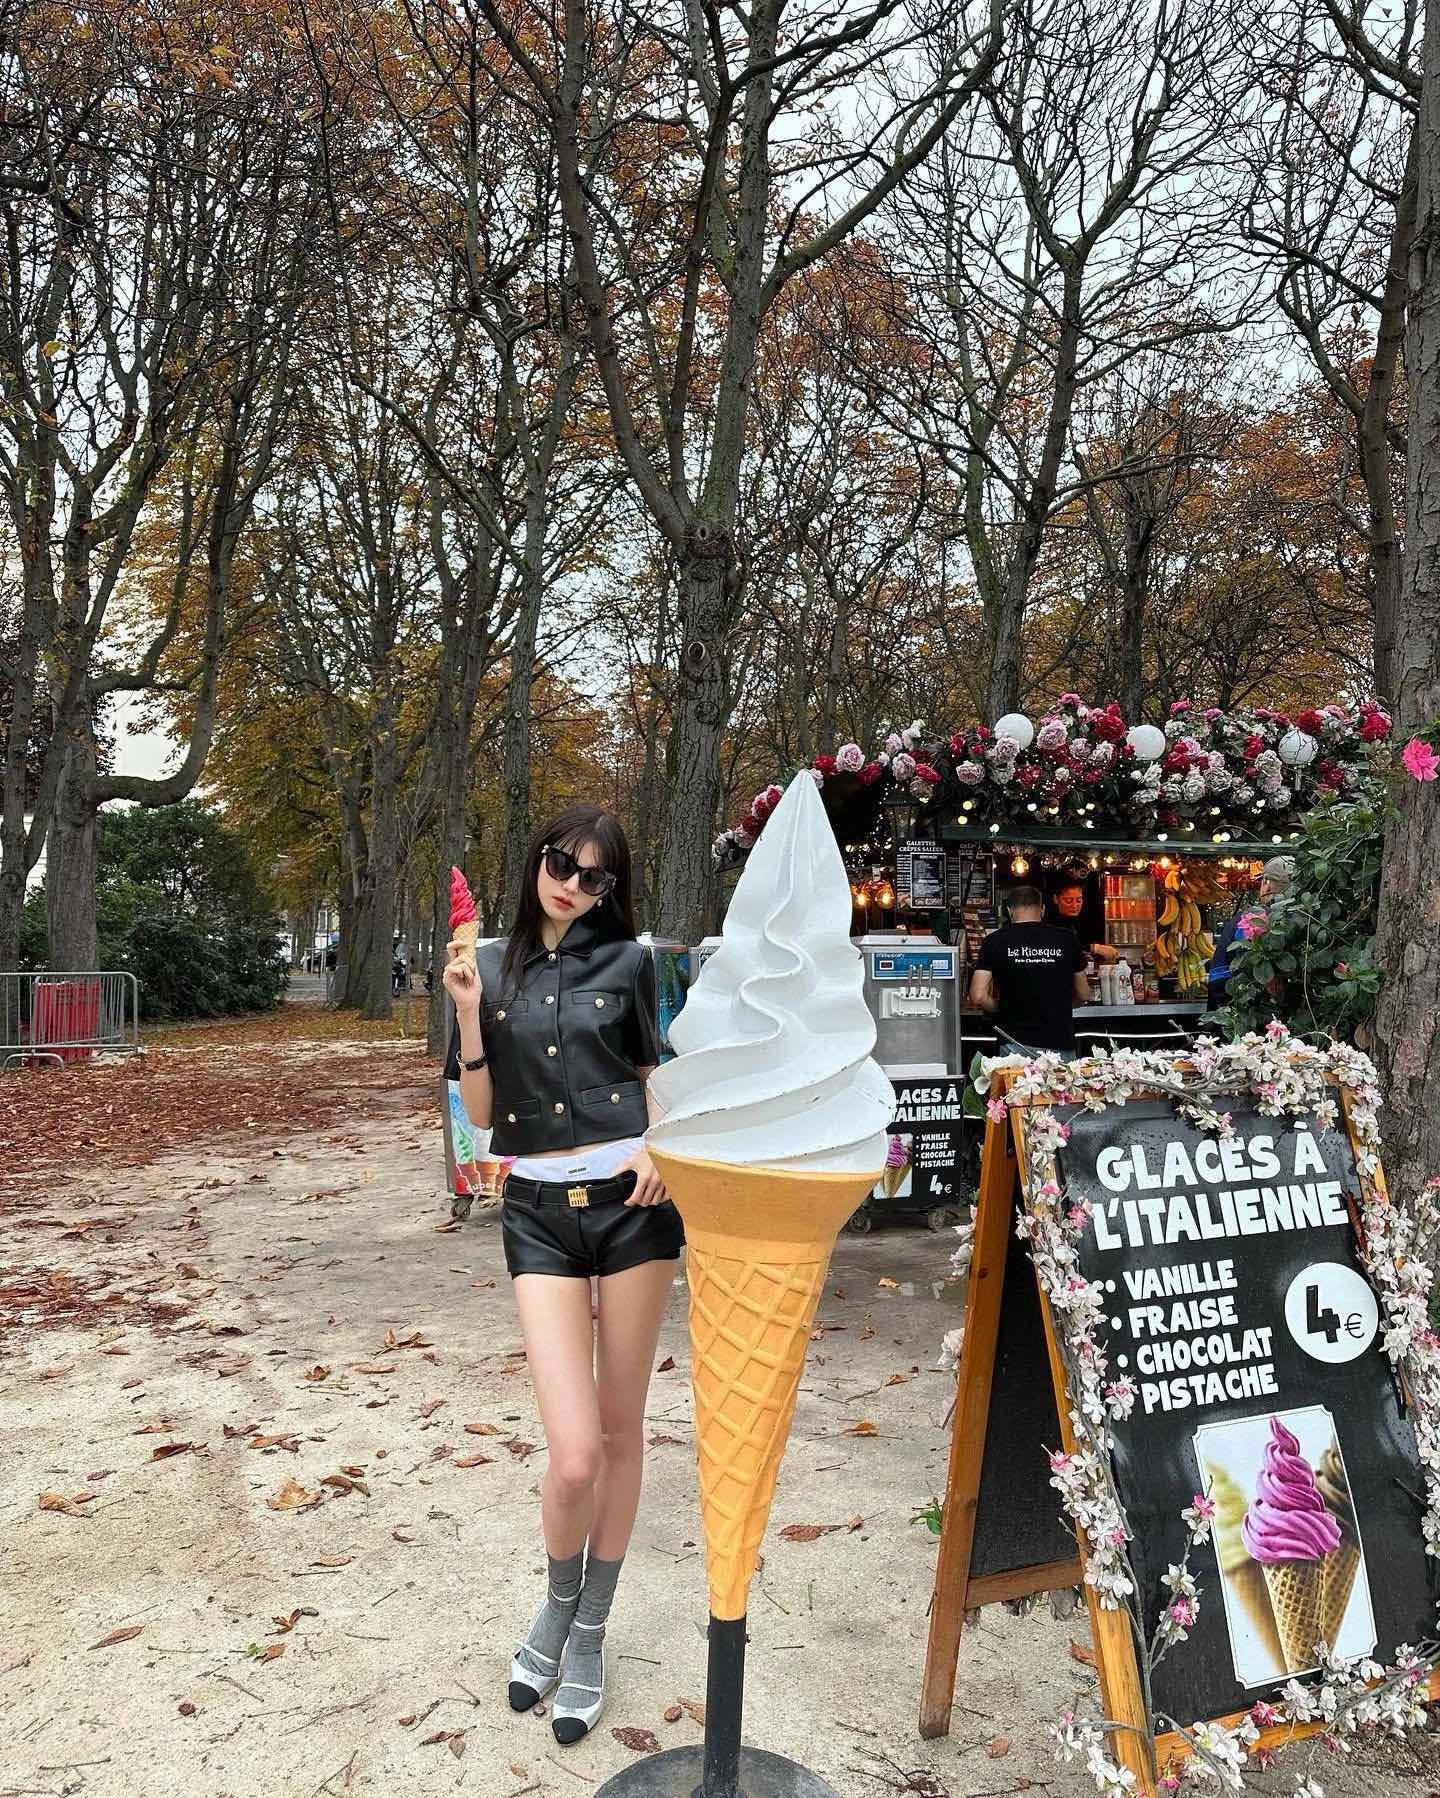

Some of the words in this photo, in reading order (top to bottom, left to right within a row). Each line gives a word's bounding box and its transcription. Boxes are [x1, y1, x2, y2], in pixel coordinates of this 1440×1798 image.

[1007, 947, 1019, 957] Le
[1021, 946, 1062, 957] Kiosque
[896, 1088, 942, 1104] ACES
[946, 1084, 958, 1103] À
[895, 1104, 961, 1122] ALIENNE
[920, 1142, 948, 1151] FRAISE
[921, 1133, 951, 1142] VANILLE
[920, 1150, 957, 1160] CHOCOLAT
[920, 1159, 955, 1169] PISTACHE
[1096, 1135, 1281, 1192] GLACES
[1293, 1121, 1328, 1176] À
[1092, 1181, 1349, 1251] L'ITALIENNE
[1122, 1259, 1238, 1300] VANILLE
[1128, 1295, 1239, 1338] FRAISE
[1136, 1326, 1273, 1374] CHOCOLAT
[1141, 1363, 1279, 1415] PISTACHE
